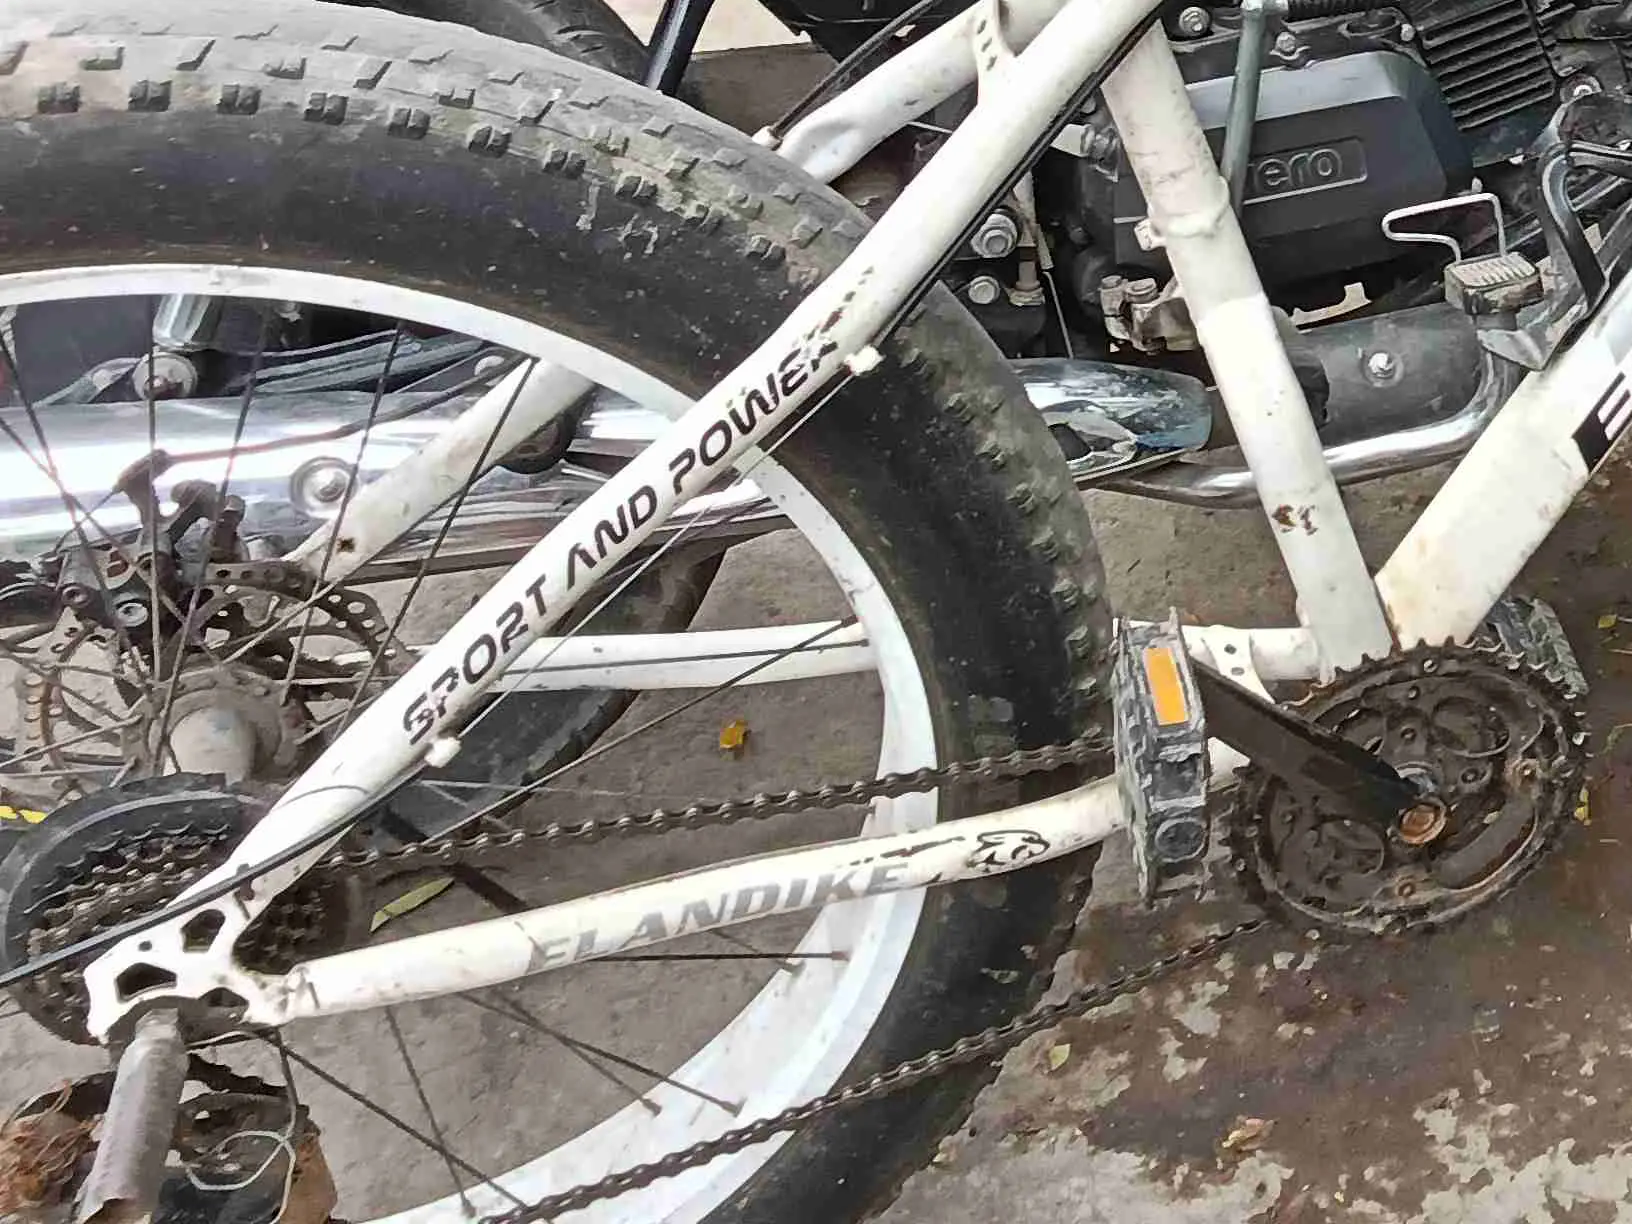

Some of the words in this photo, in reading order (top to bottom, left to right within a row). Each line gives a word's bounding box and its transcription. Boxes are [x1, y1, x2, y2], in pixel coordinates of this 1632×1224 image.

[1248, 147, 1344, 188] ero
[402, 575, 552, 747] SPORT
[565, 485, 661, 594] AND
[530, 859, 911, 975] ELANDIKE
